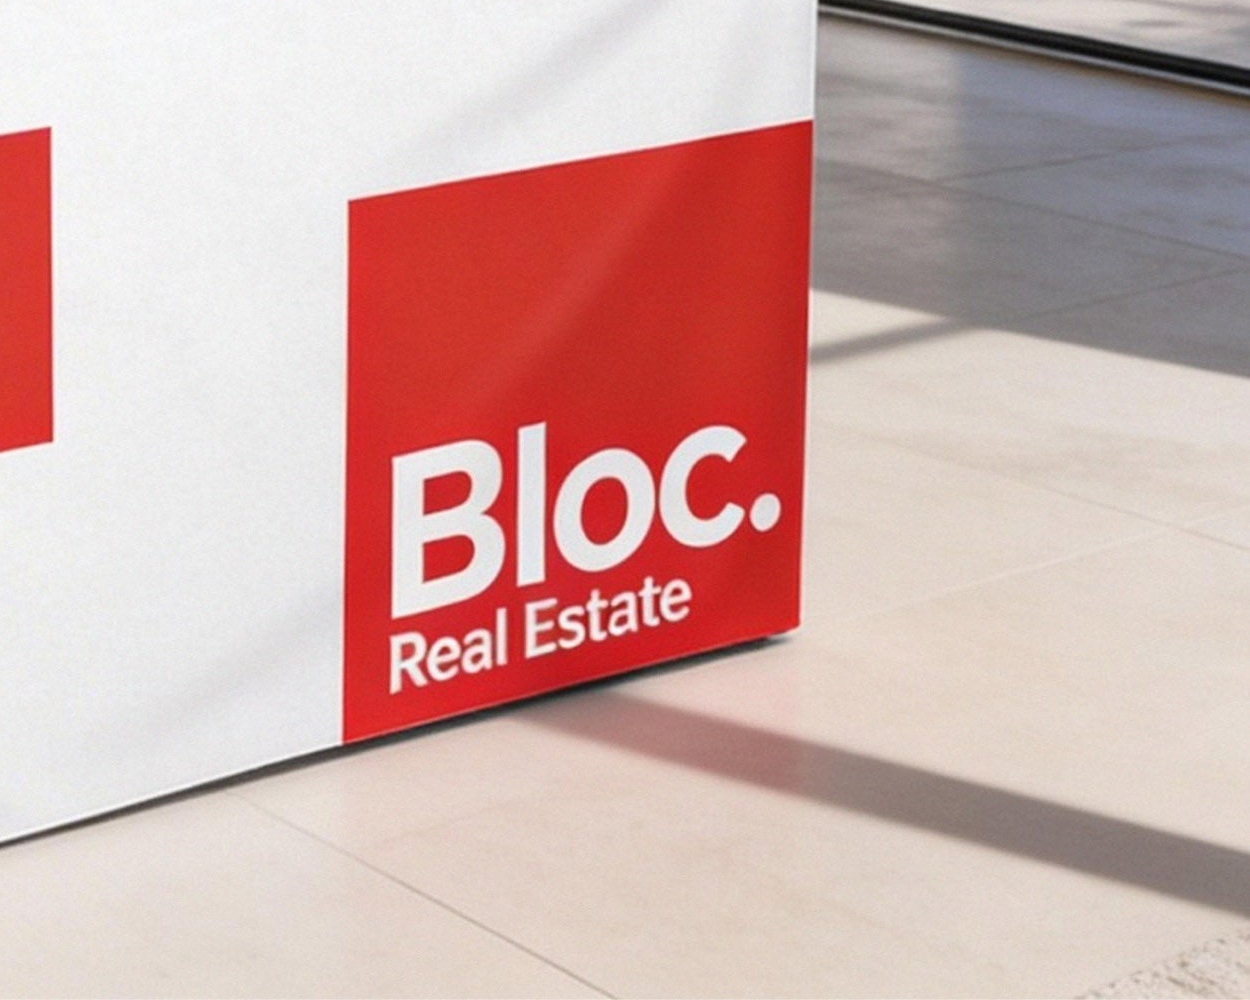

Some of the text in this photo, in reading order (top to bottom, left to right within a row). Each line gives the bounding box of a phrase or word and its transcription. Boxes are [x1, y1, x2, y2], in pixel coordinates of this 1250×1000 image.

[391, 421, 781, 619] Bloc.
[389, 575, 692, 695] Real Estate
